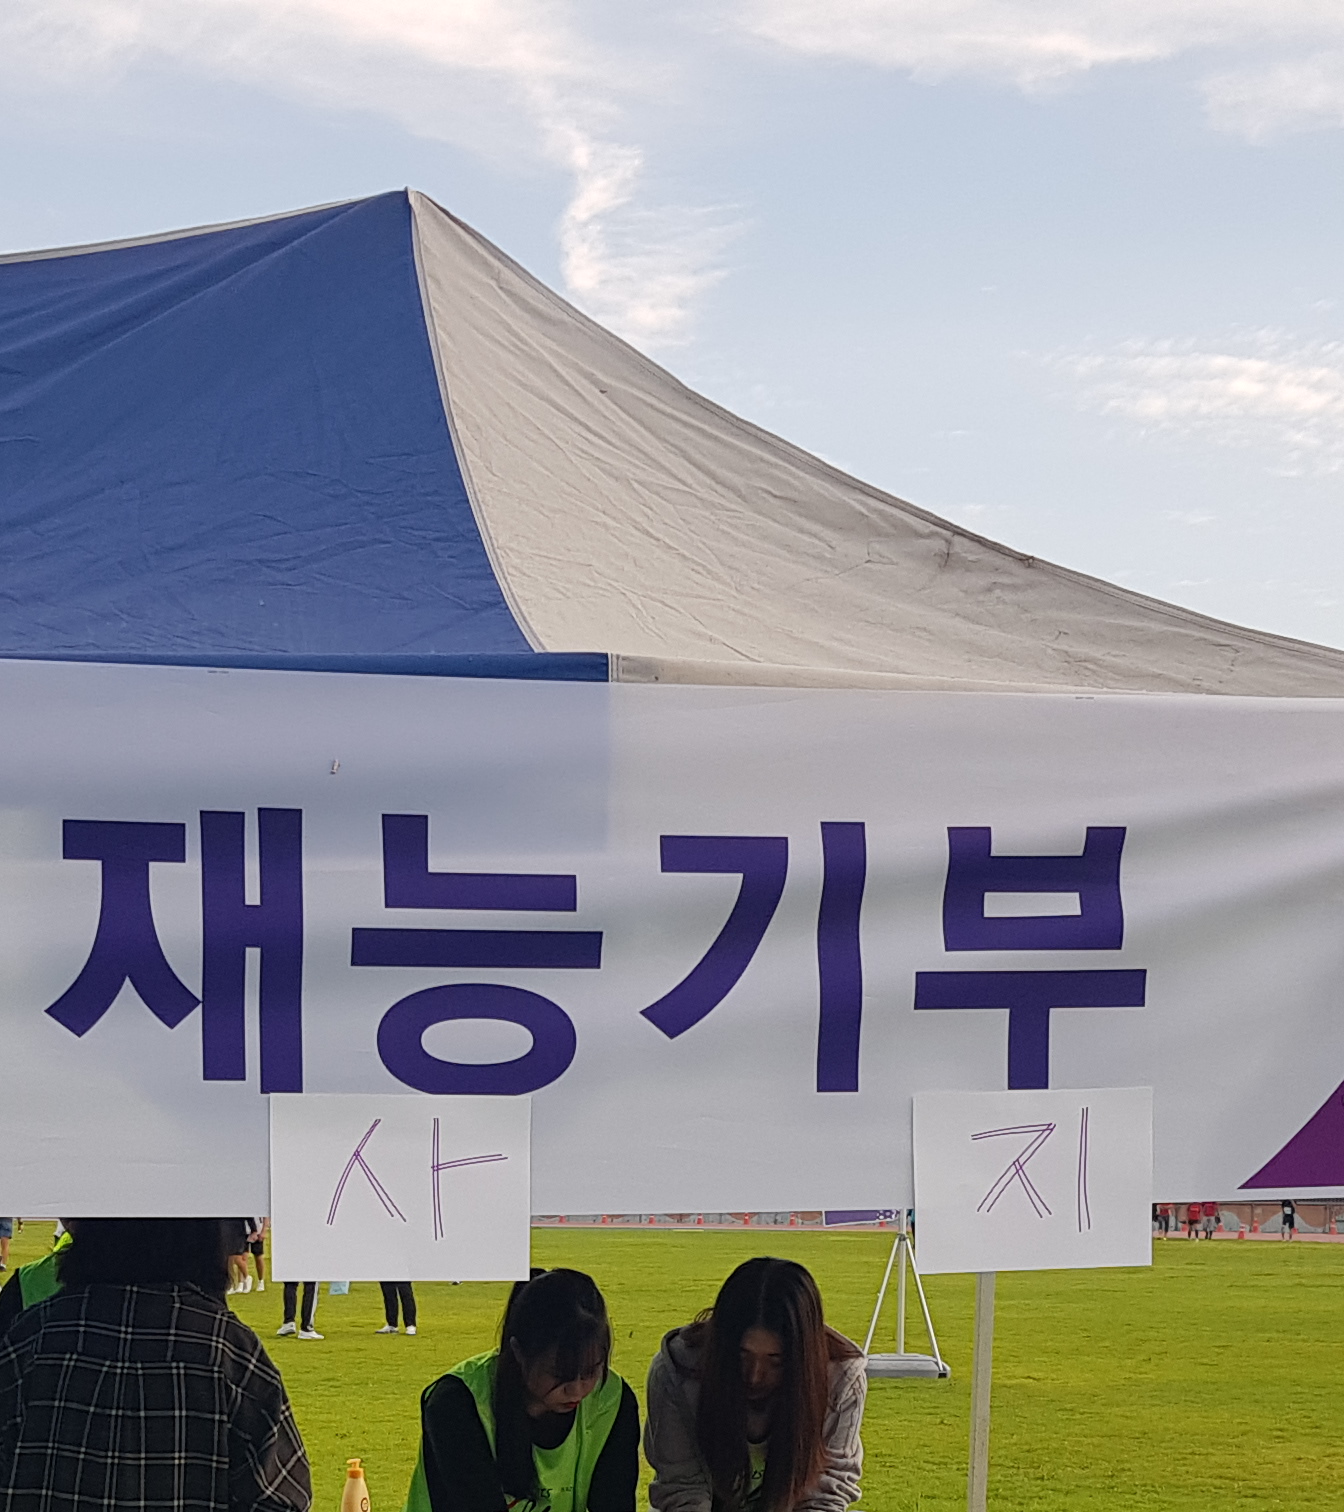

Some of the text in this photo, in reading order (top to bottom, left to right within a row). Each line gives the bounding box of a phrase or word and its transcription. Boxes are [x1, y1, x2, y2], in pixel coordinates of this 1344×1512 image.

[44, 807, 1147, 1096] 재능기부
[327, 1117, 508, 1240] 사
[970, 1106, 1091, 1233] 지
